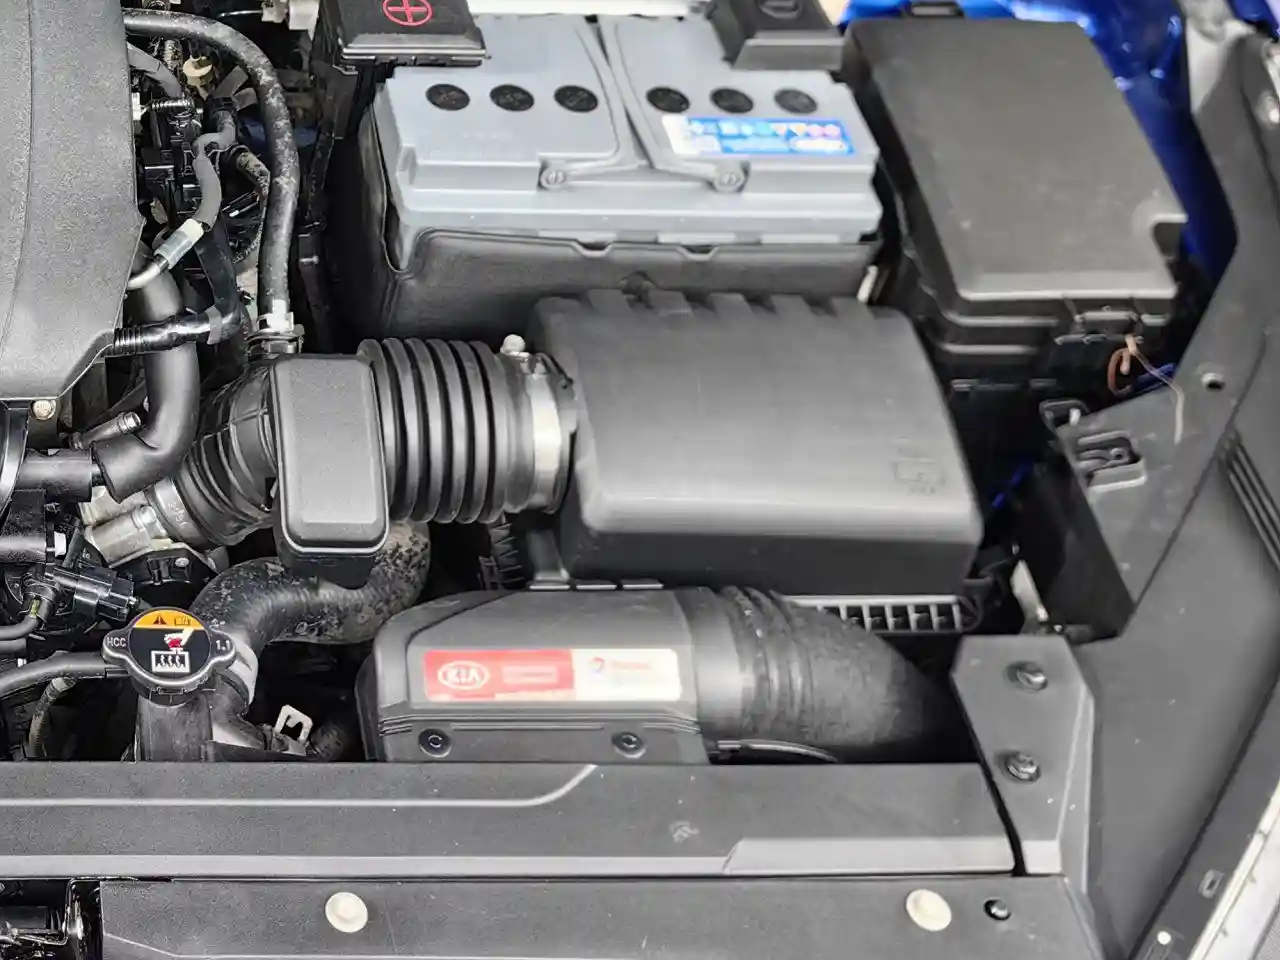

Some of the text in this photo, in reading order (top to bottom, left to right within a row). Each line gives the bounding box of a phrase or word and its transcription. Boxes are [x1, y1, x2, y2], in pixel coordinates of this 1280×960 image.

[106, 636, 127, 648] HCC
[215, 639, 231, 651] 1.1
[446, 666, 482, 683] KIA
